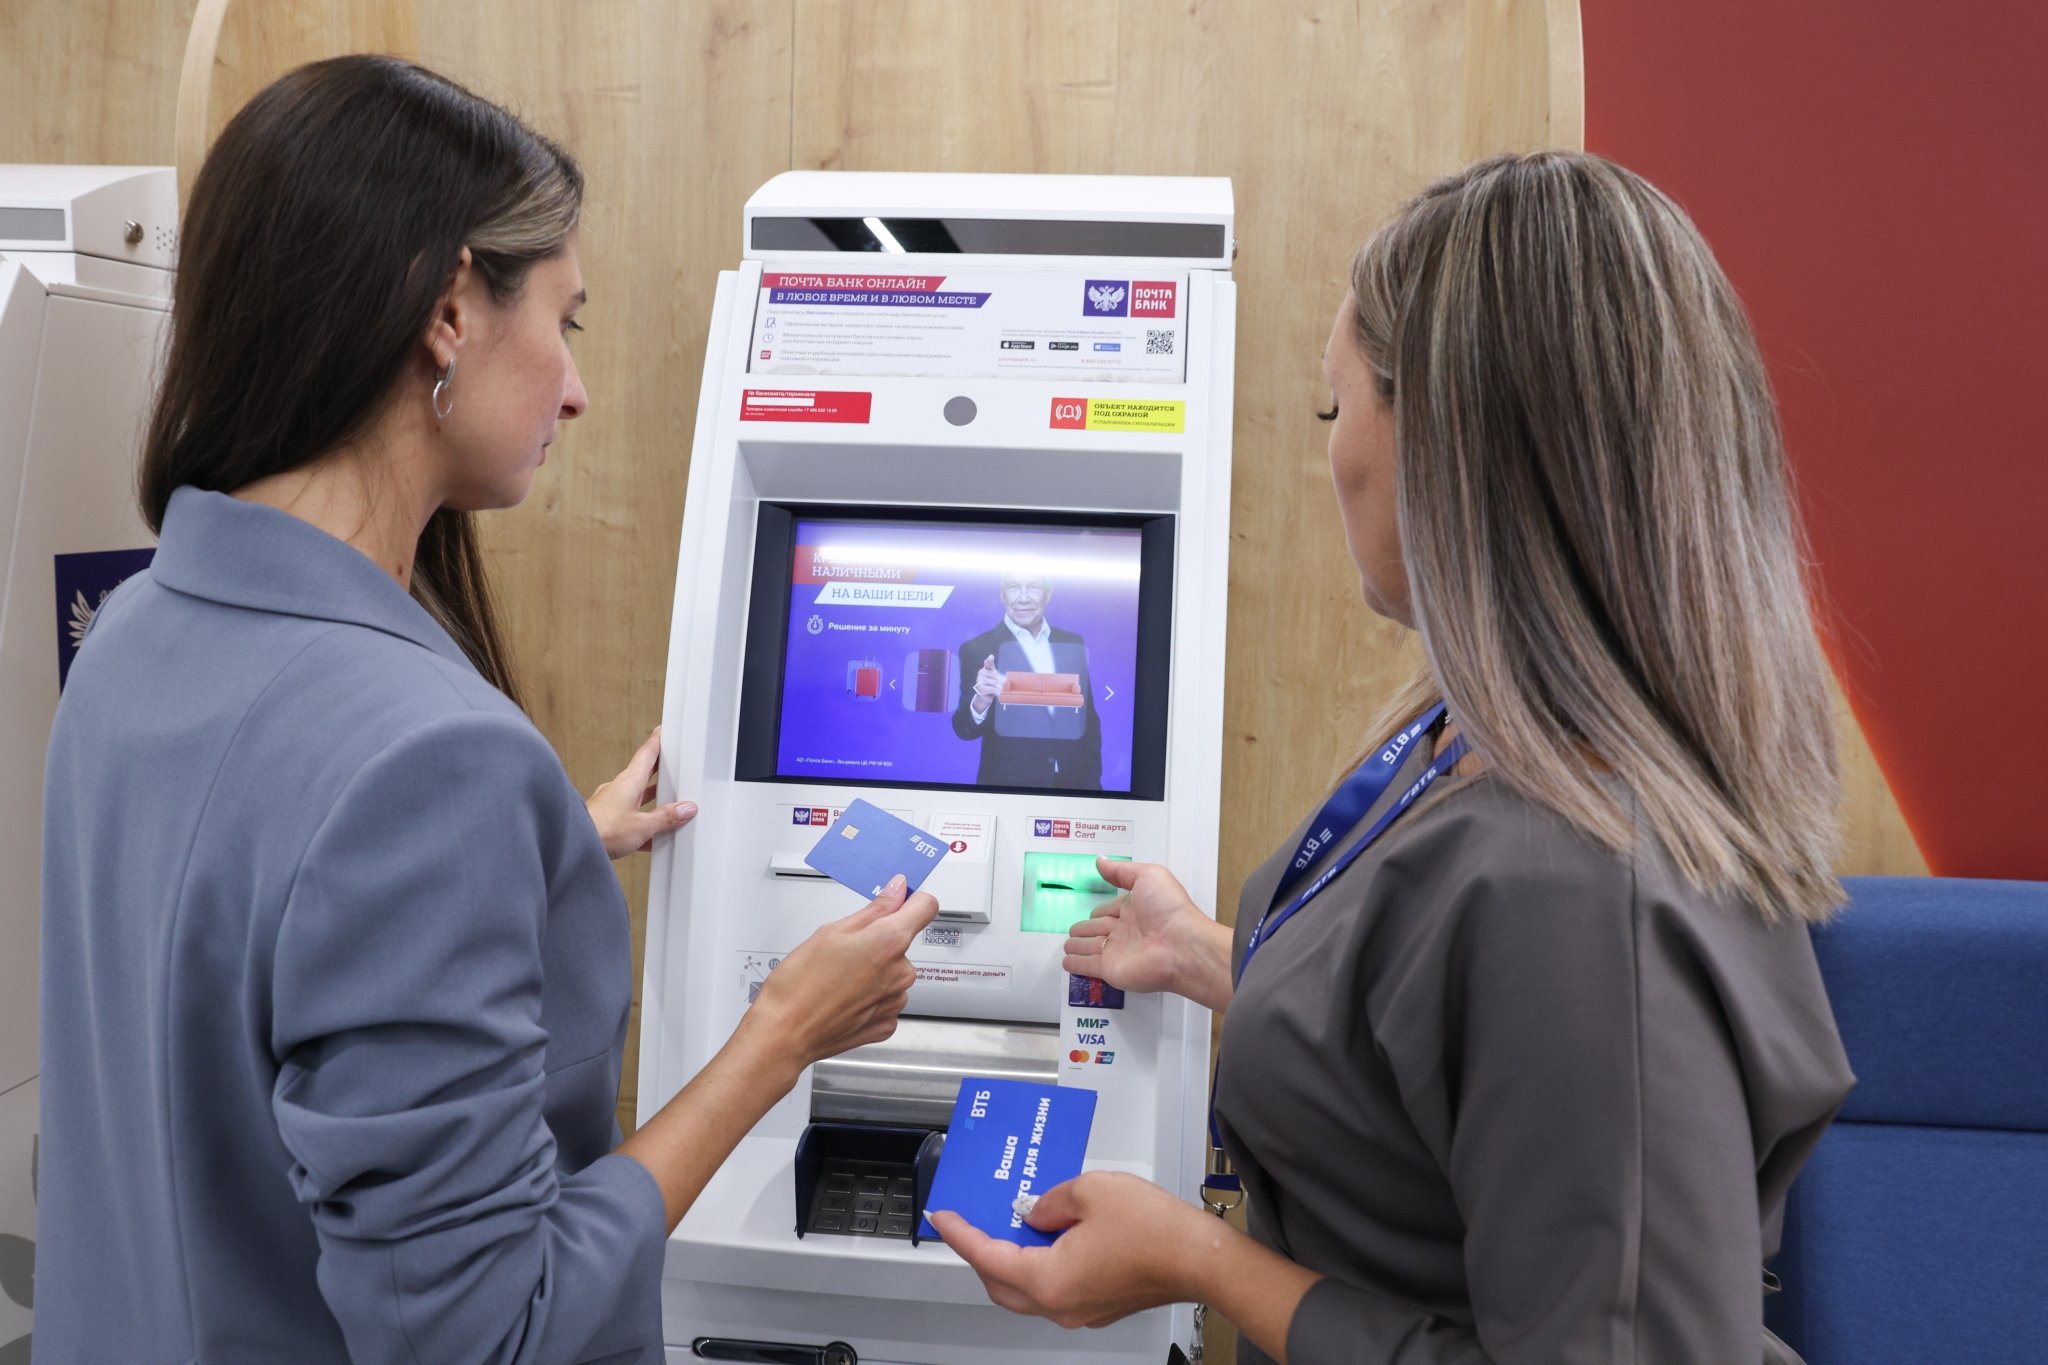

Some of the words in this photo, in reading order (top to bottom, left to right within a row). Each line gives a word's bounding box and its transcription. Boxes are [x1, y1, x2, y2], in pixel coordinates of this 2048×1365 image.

[778, 276, 823, 287] ПОЧТА
[826, 277, 864, 288] БАНК
[866, 276, 926, 289] ОНЛАЙН
[776, 292, 784, 300] В
[786, 292, 827, 302] ЛЮБОЕ
[829, 293, 868, 303] ВРЕМЯ
[870, 294, 879, 303] И
[881, 294, 889, 303] В
[891, 294, 935, 304] ЛЮБОМ
[938, 295, 977, 305] МЕСТЕ
[1135, 288, 1173, 299] ПОЧТА
[1135, 299, 1167, 310] БАНК
[1127, 404, 1175, 412] НАХОДИТСЯ
[812, 566, 901, 579] НАЛИЧНЫМИ
[832, 588, 850, 598] НА
[853, 588, 894, 600] ВАШИ
[896, 590, 934, 602] ЦЕЛИ
[828, 621, 867, 631] Решение
[879, 624, 911, 634] минуту
[1382, 732, 1410, 765] ВТБ
[1408, 766, 1437, 797] ВТБ
[1075, 822, 1099, 830] Ваша
[1101, 824, 1127, 832] карта
[1074, 831, 1096, 839] Card
[914, 840, 939, 858] ВТБ
[1295, 837, 1320, 870] ВТБ
[925, 928, 960, 937] DIEBOLD
[924, 937, 960, 946] NIXDORF
[934, 974, 959, 983] deposit
[1076, 1018, 1110, 1029] МИР
[1076, 1033, 1106, 1045] VISA
[970, 1090, 991, 1118] ВТБ
[1030, 1097, 1051, 1145] жизни
[994, 1135, 1018, 1180] Ваша
[1023, 1148, 1039, 1178] для
